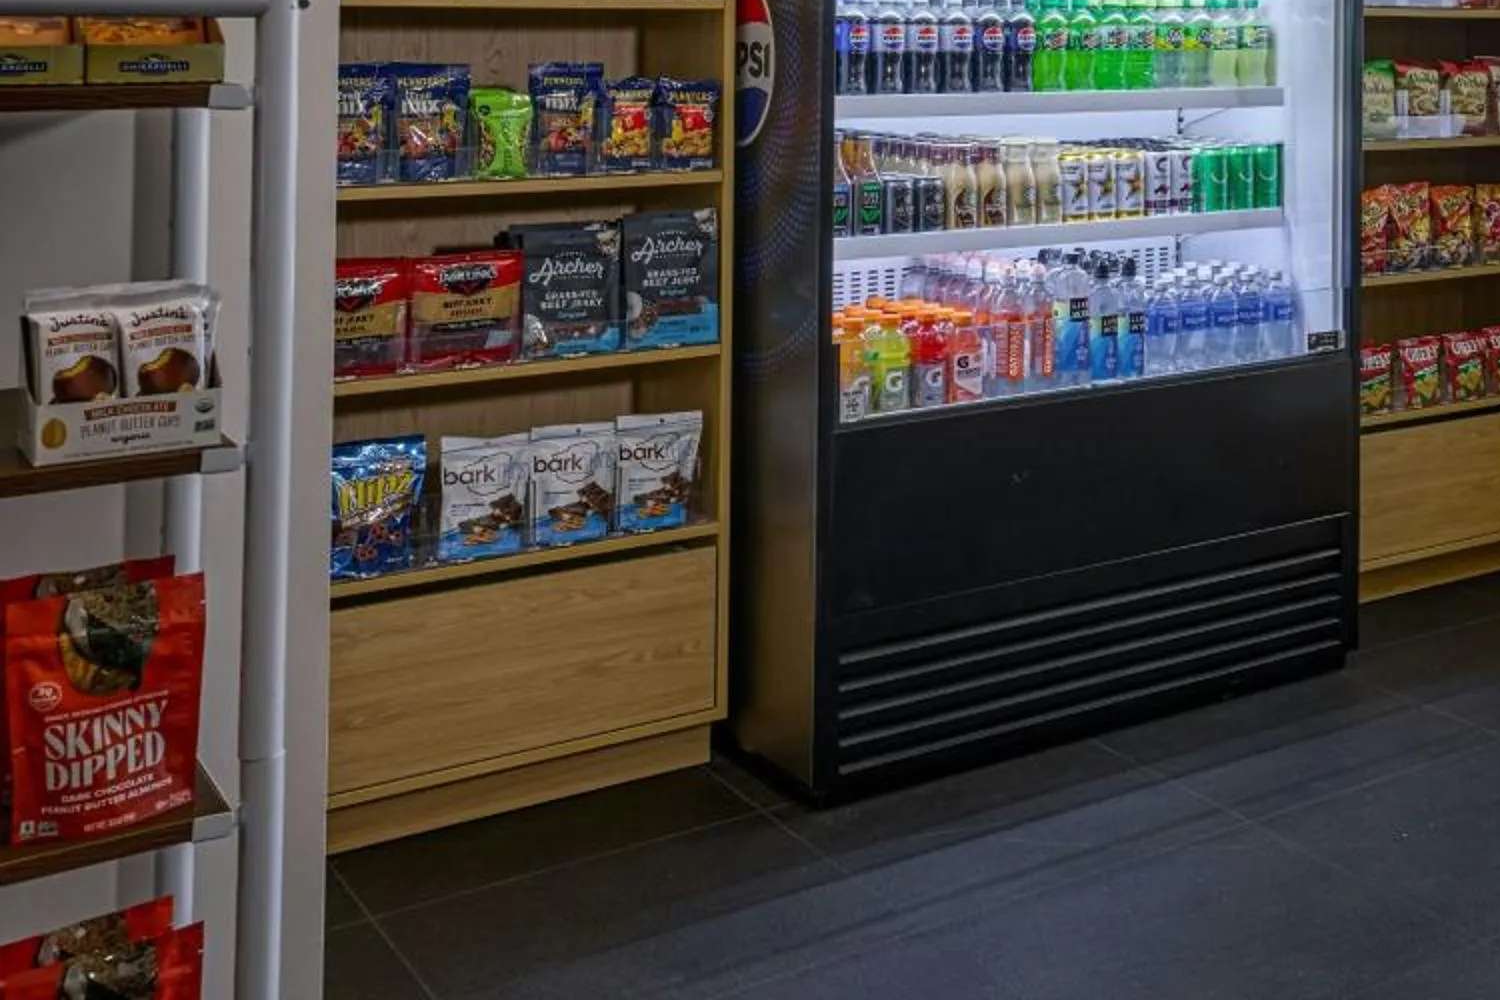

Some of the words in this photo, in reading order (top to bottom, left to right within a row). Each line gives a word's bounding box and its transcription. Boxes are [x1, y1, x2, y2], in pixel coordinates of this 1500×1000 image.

[737, 41, 770, 78] PSI
[631, 236, 703, 264] Archer
[529, 257, 604, 286] Archer
[533, 454, 583, 473] bark
[619, 443, 665, 461] bark
[444, 464, 497, 485] bark
[44, 699, 168, 761] SKINNY
[45, 730, 165, 792] DIPPED
[94, 773, 154, 798] CHOCOLATE
